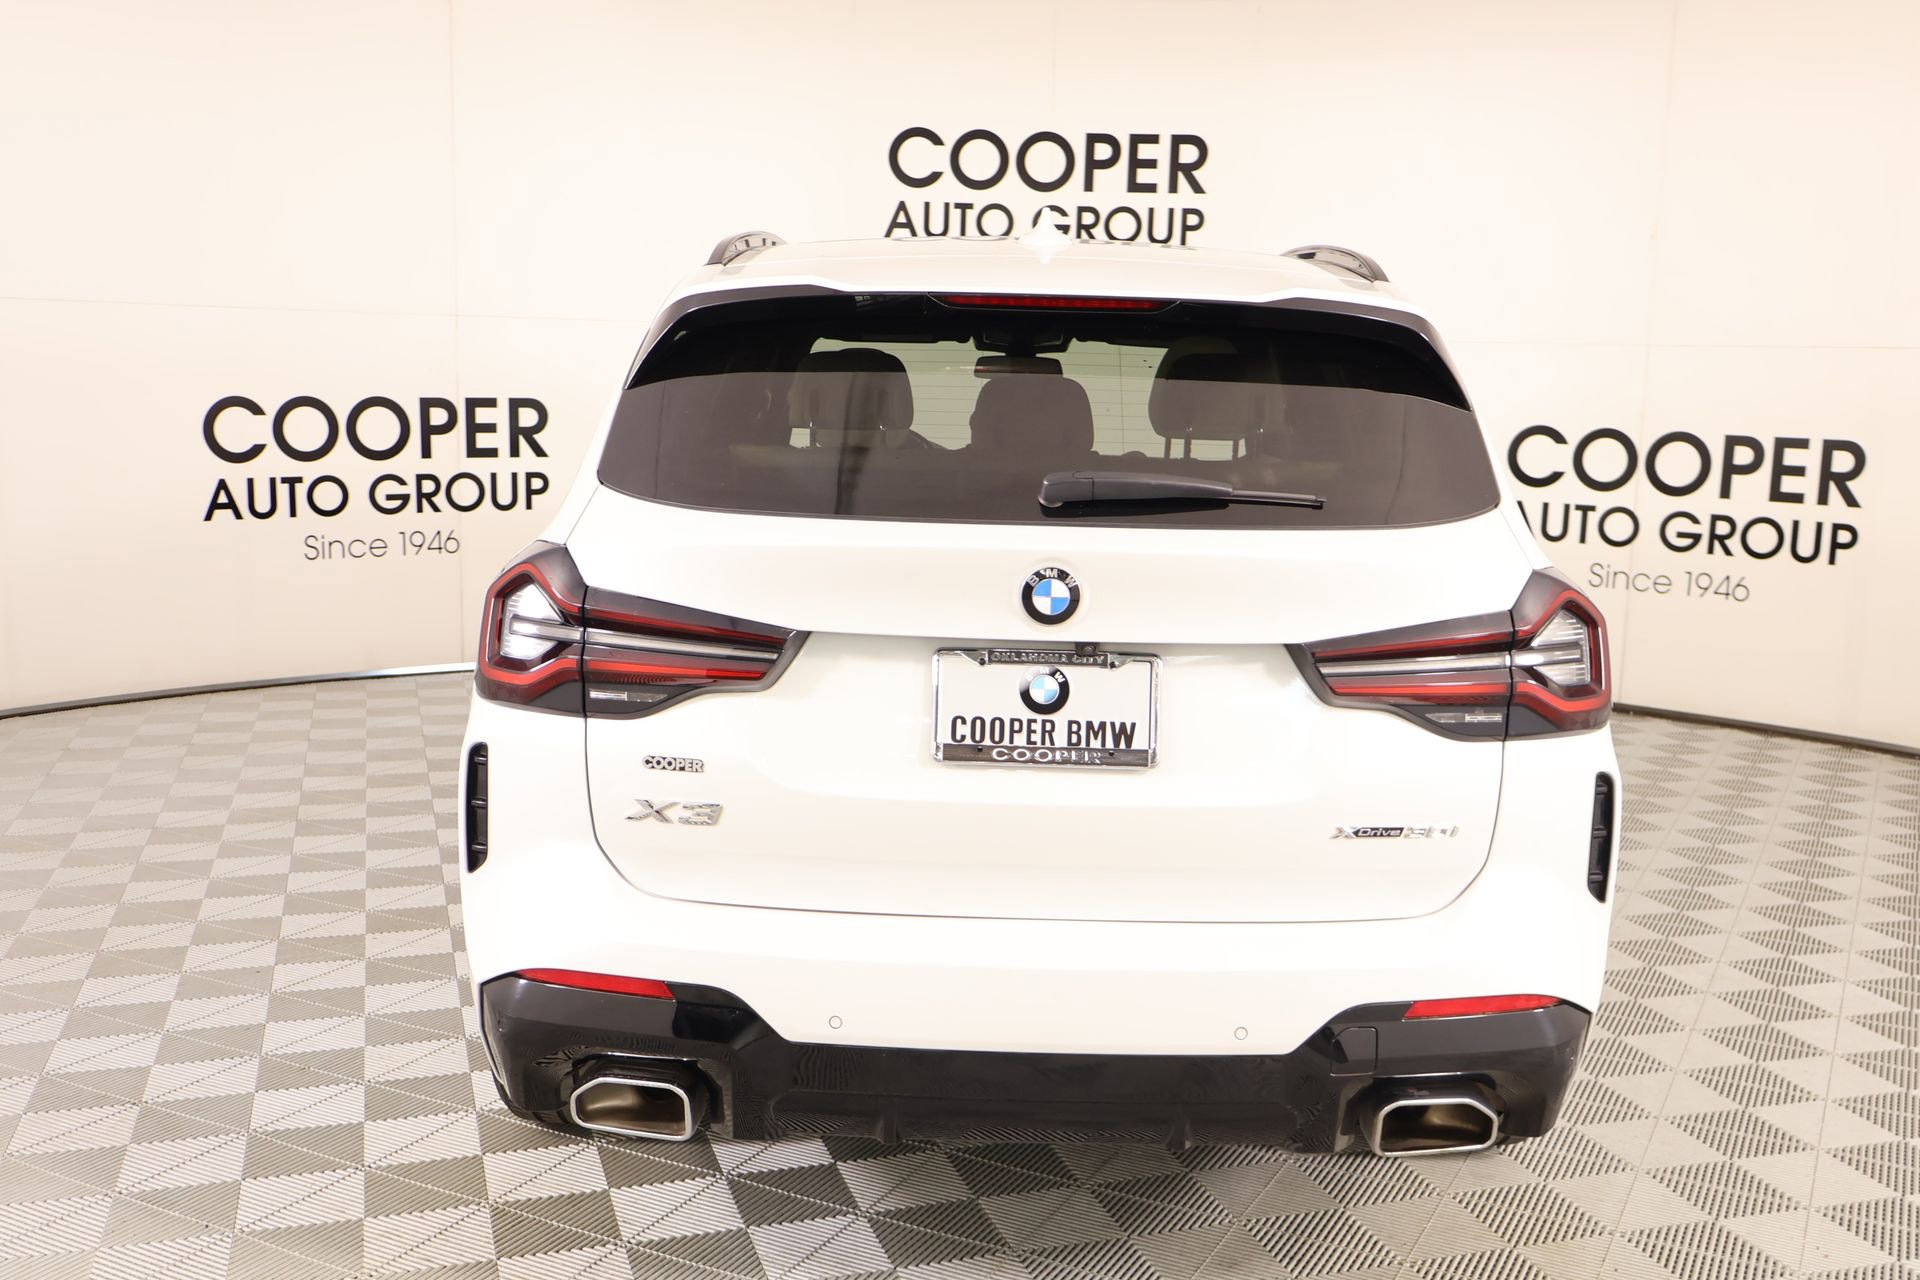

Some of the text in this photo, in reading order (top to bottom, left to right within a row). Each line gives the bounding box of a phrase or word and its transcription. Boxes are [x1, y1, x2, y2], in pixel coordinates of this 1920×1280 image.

[889, 127, 1208, 194] COOPER
[884, 201, 1014, 238] AUTO
[203, 395, 549, 464] COOPER
[1507, 424, 1866, 508] COOPER
[203, 472, 549, 522] AUTO GROUP
[304, 529, 460, 561] Since 1946
[1516, 500, 1858, 565] UTO GROUP
[1027, 568, 1079, 588] BMW
[1587, 562, 1750, 602] Since 1946
[991, 652, 1105, 664] OKLAHOMA CITY
[951, 715, 1137, 749] COOPER BMW
[642, 755, 704, 773] COOPER
[991, 748, 1103, 764] COOPER
[624, 798, 724, 826] X3
